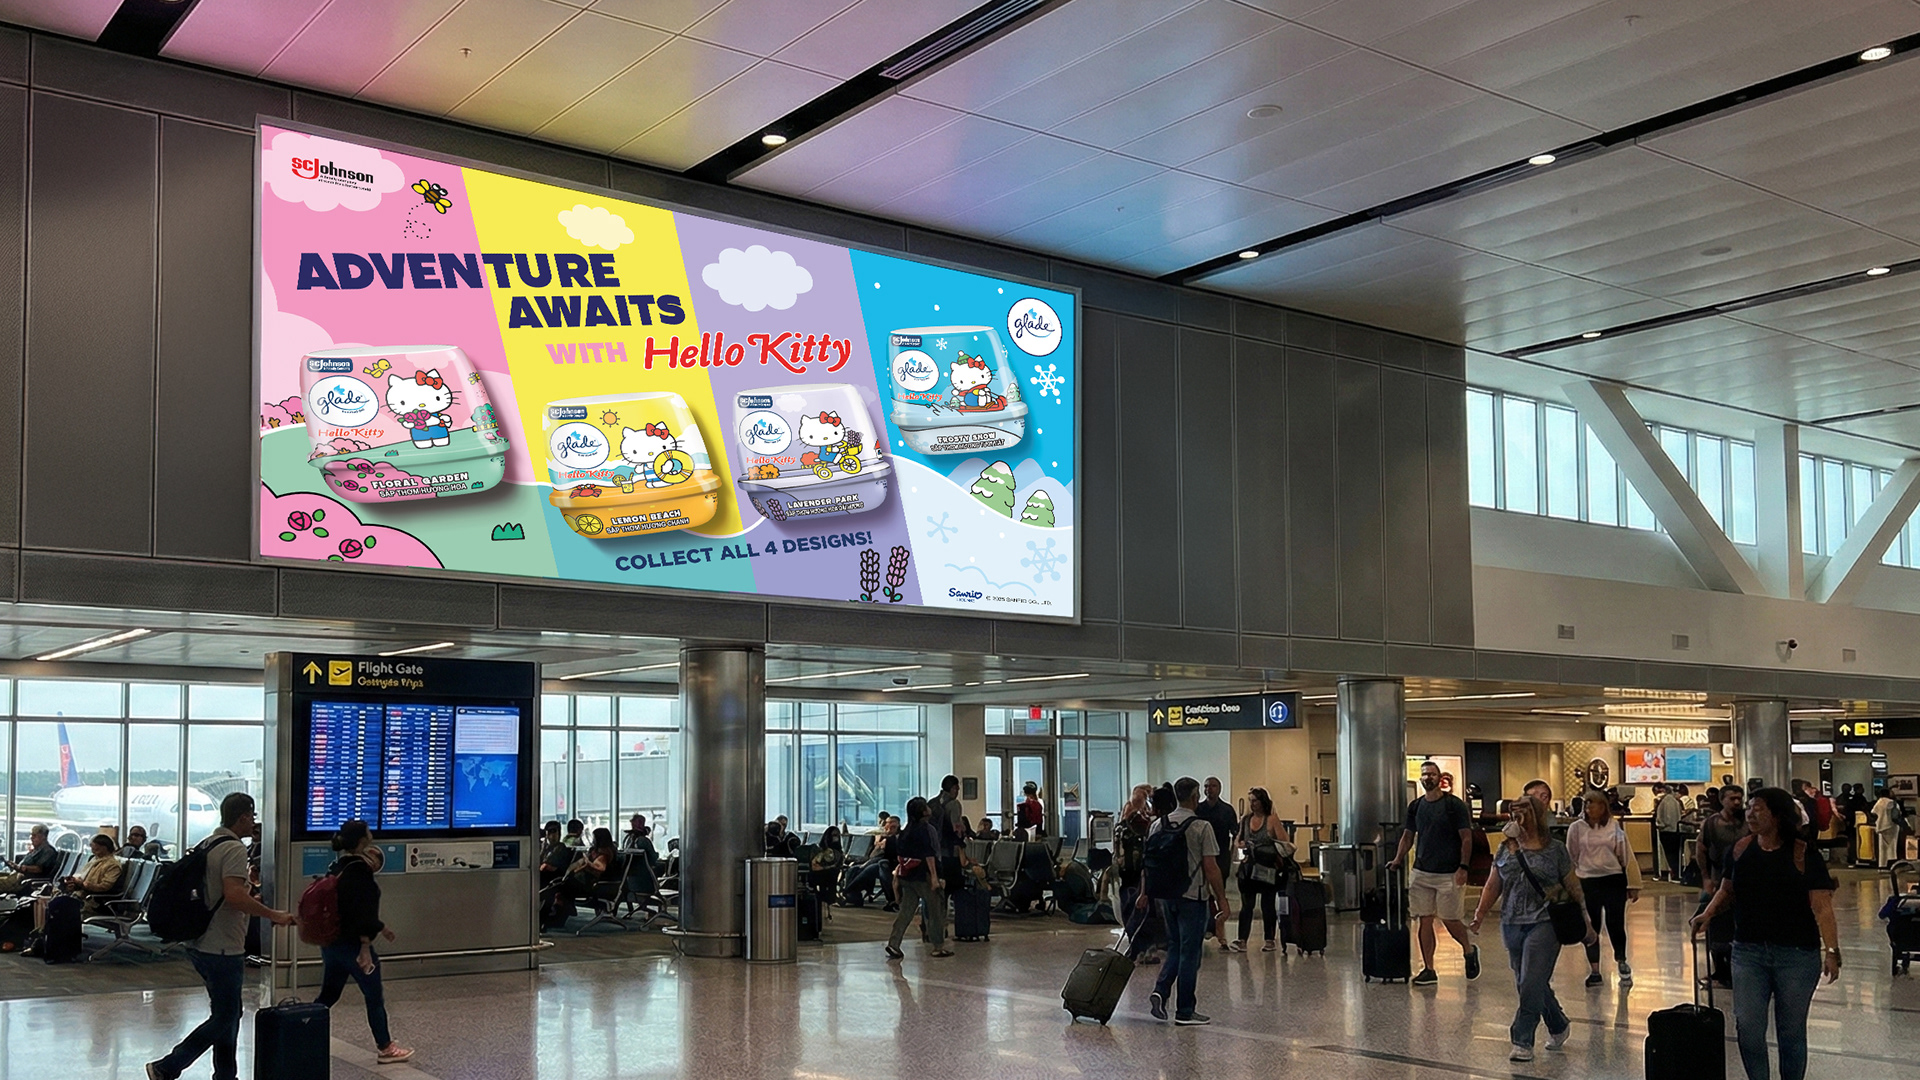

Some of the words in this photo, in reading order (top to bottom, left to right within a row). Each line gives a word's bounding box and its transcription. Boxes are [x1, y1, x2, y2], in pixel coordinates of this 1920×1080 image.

[297, 252, 621, 290] ADVENTURE
[508, 294, 686, 329] AWAITS
[545, 341, 628, 365] WITH
[644, 331, 745, 369] Hello
[747, 331, 851, 374] Kitty
[898, 392, 919, 400] Hello
[920, 393, 943, 402] Kitty
[318, 428, 350, 437] Hello
[351, 428, 384, 438] Kitty
[972, 432, 996, 441] SNOW
[746, 456, 770, 464] Hello
[771, 456, 796, 465] Kitty
[372, 479, 417, 489] FLORAL
[422, 472, 468, 484] GARDEN
[558, 470, 586, 479] Hello
[586, 470, 615, 480] Kitty
[787, 498, 831, 508] LAVENDER
[835, 494, 858, 503] PARK
[611, 514, 646, 525] LEMON
[650, 509, 681, 520] BEACH
[615, 547, 713, 571] COLLECT
[720, 544, 760, 561] ALL
[764, 540, 778, 556] 4
[782, 530, 873, 554] DESIGNS!
[358, 661, 393, 677] Flight
[396, 663, 423, 675] Gate
